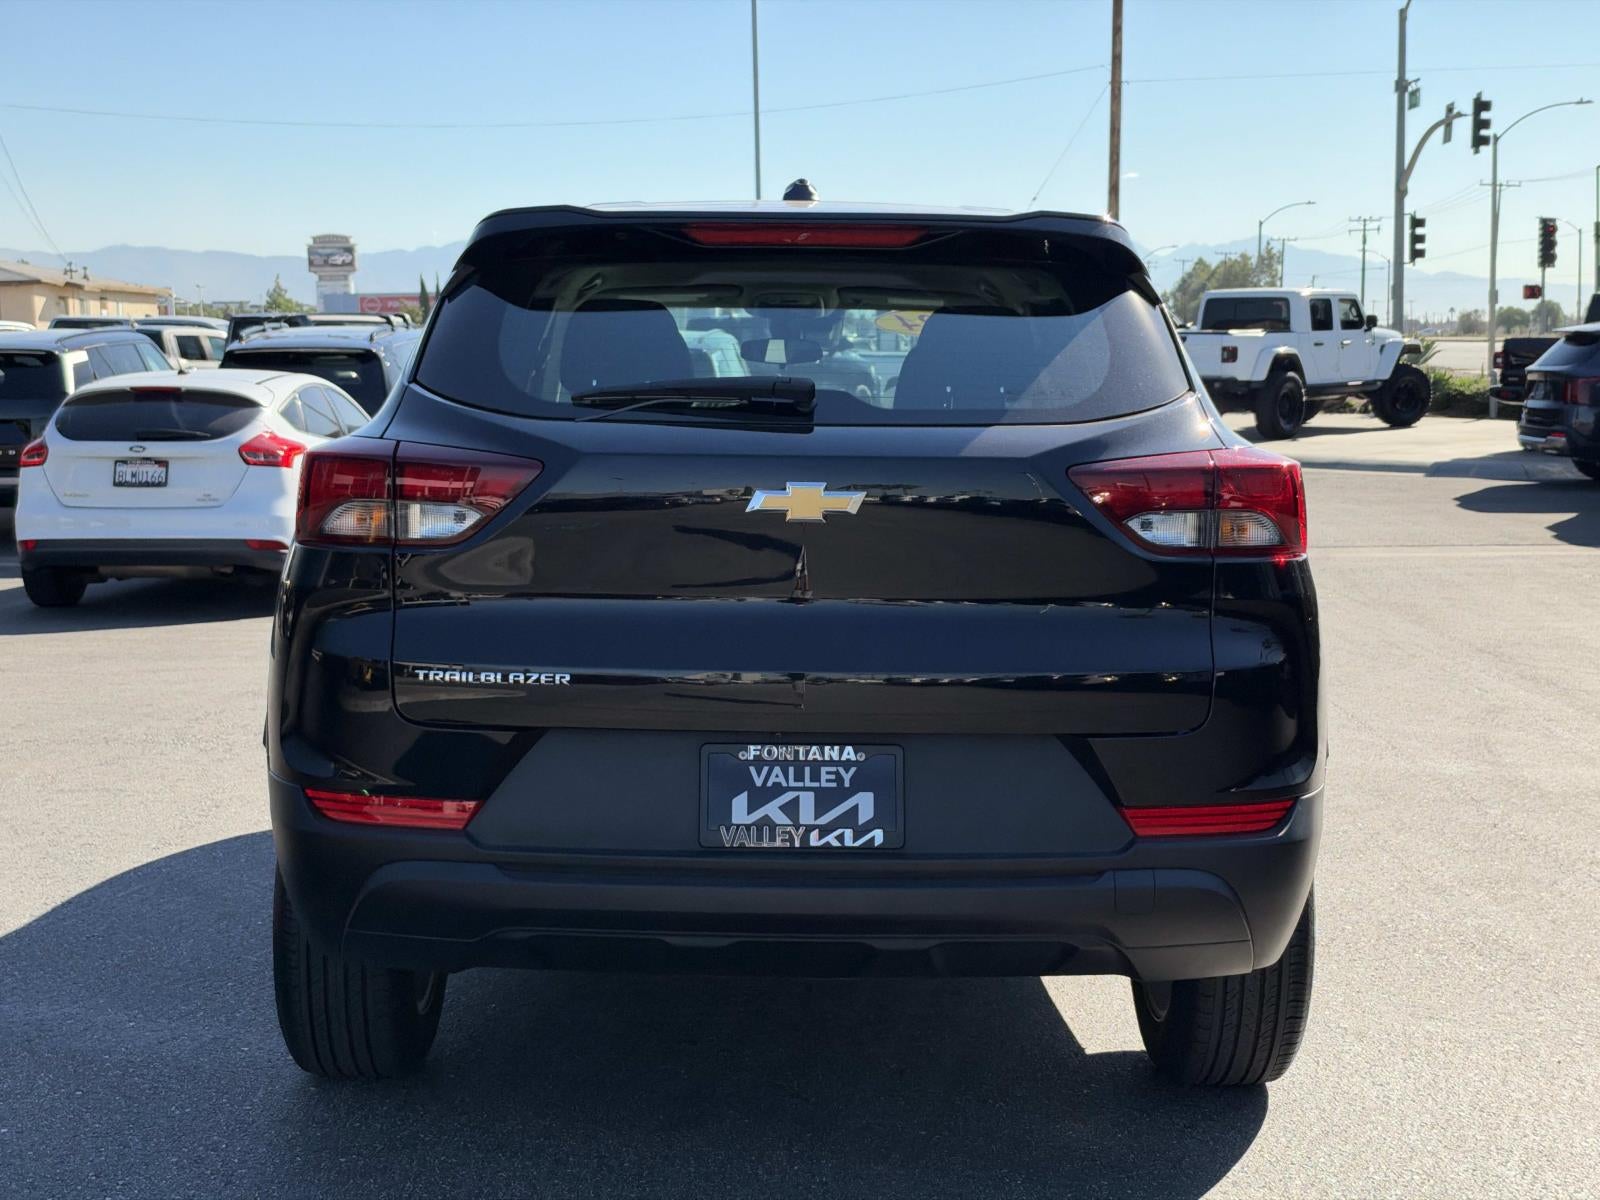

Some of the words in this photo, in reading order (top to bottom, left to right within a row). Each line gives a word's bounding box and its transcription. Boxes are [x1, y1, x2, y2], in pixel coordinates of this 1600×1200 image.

[414, 669, 572, 686] TRAILBLAZER
[747, 745, 857, 761] FONTANA
[749, 766, 857, 788] VALLEY
[731, 790, 875, 825] KIA
[720, 825, 806, 848] VALLEY
[809, 828, 884, 847] KIA
